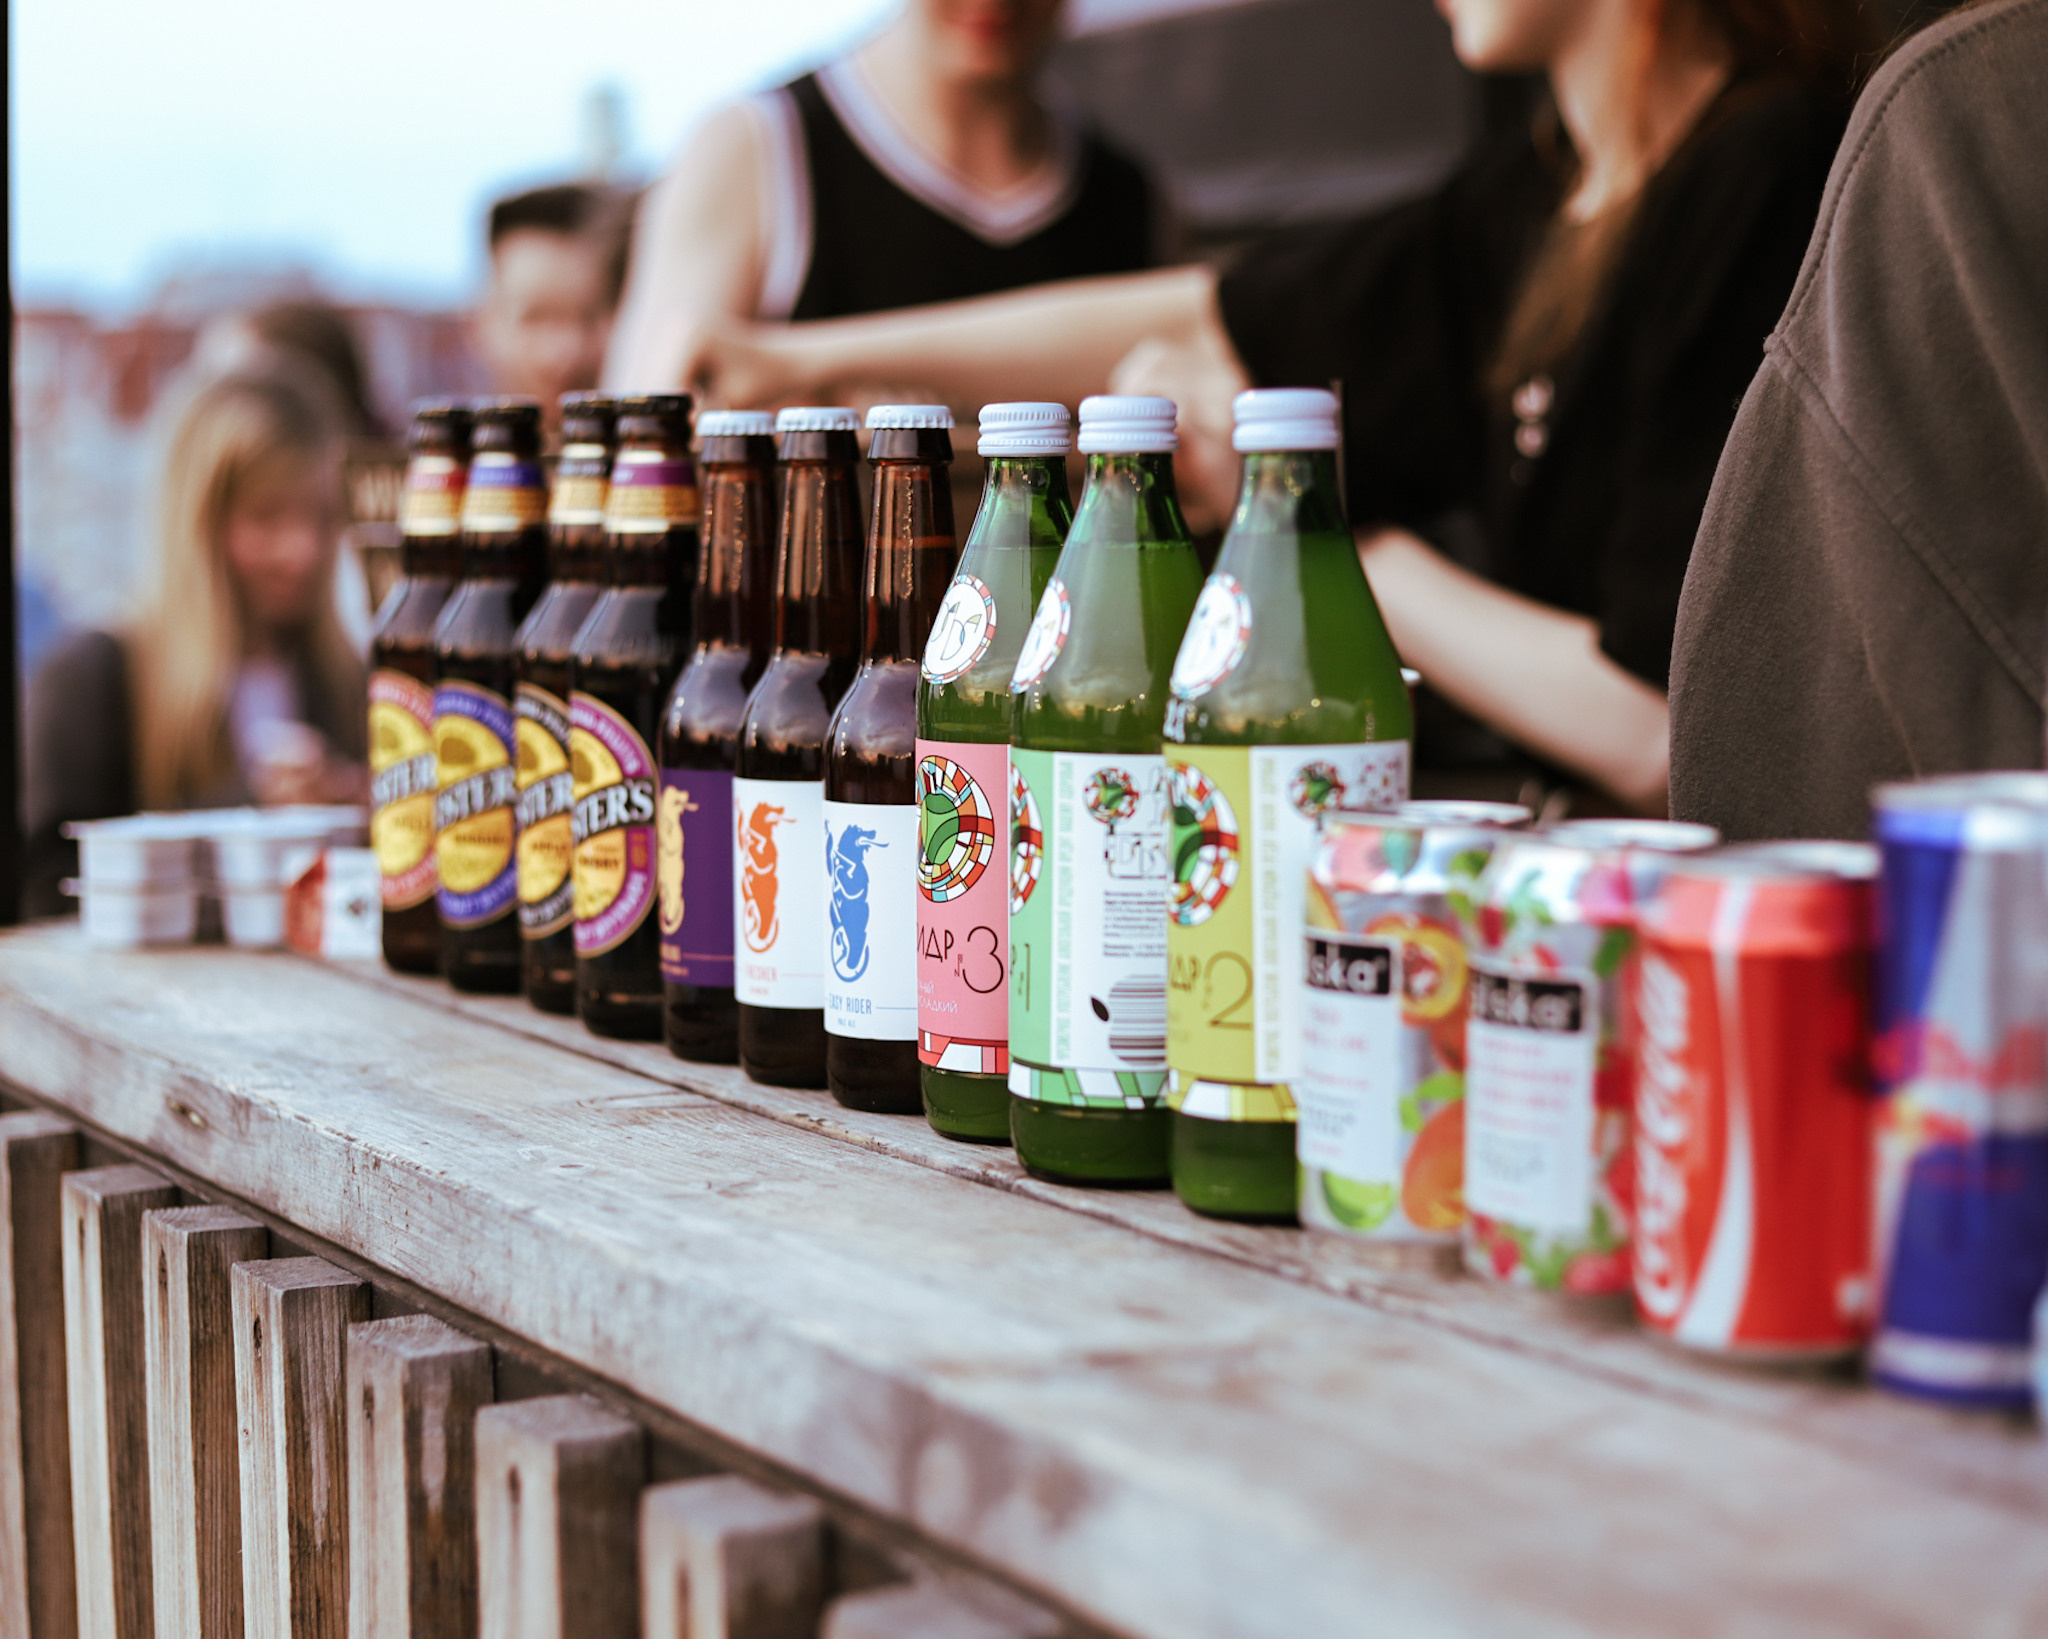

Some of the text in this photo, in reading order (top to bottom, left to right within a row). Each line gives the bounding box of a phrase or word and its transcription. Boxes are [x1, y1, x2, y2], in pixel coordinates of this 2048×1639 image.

[917, 924, 954, 963] ИДР
[962, 925, 1004, 994] 3
[1203, 951, 1254, 1031] 2
[846, 996, 872, 1015] RIDER
